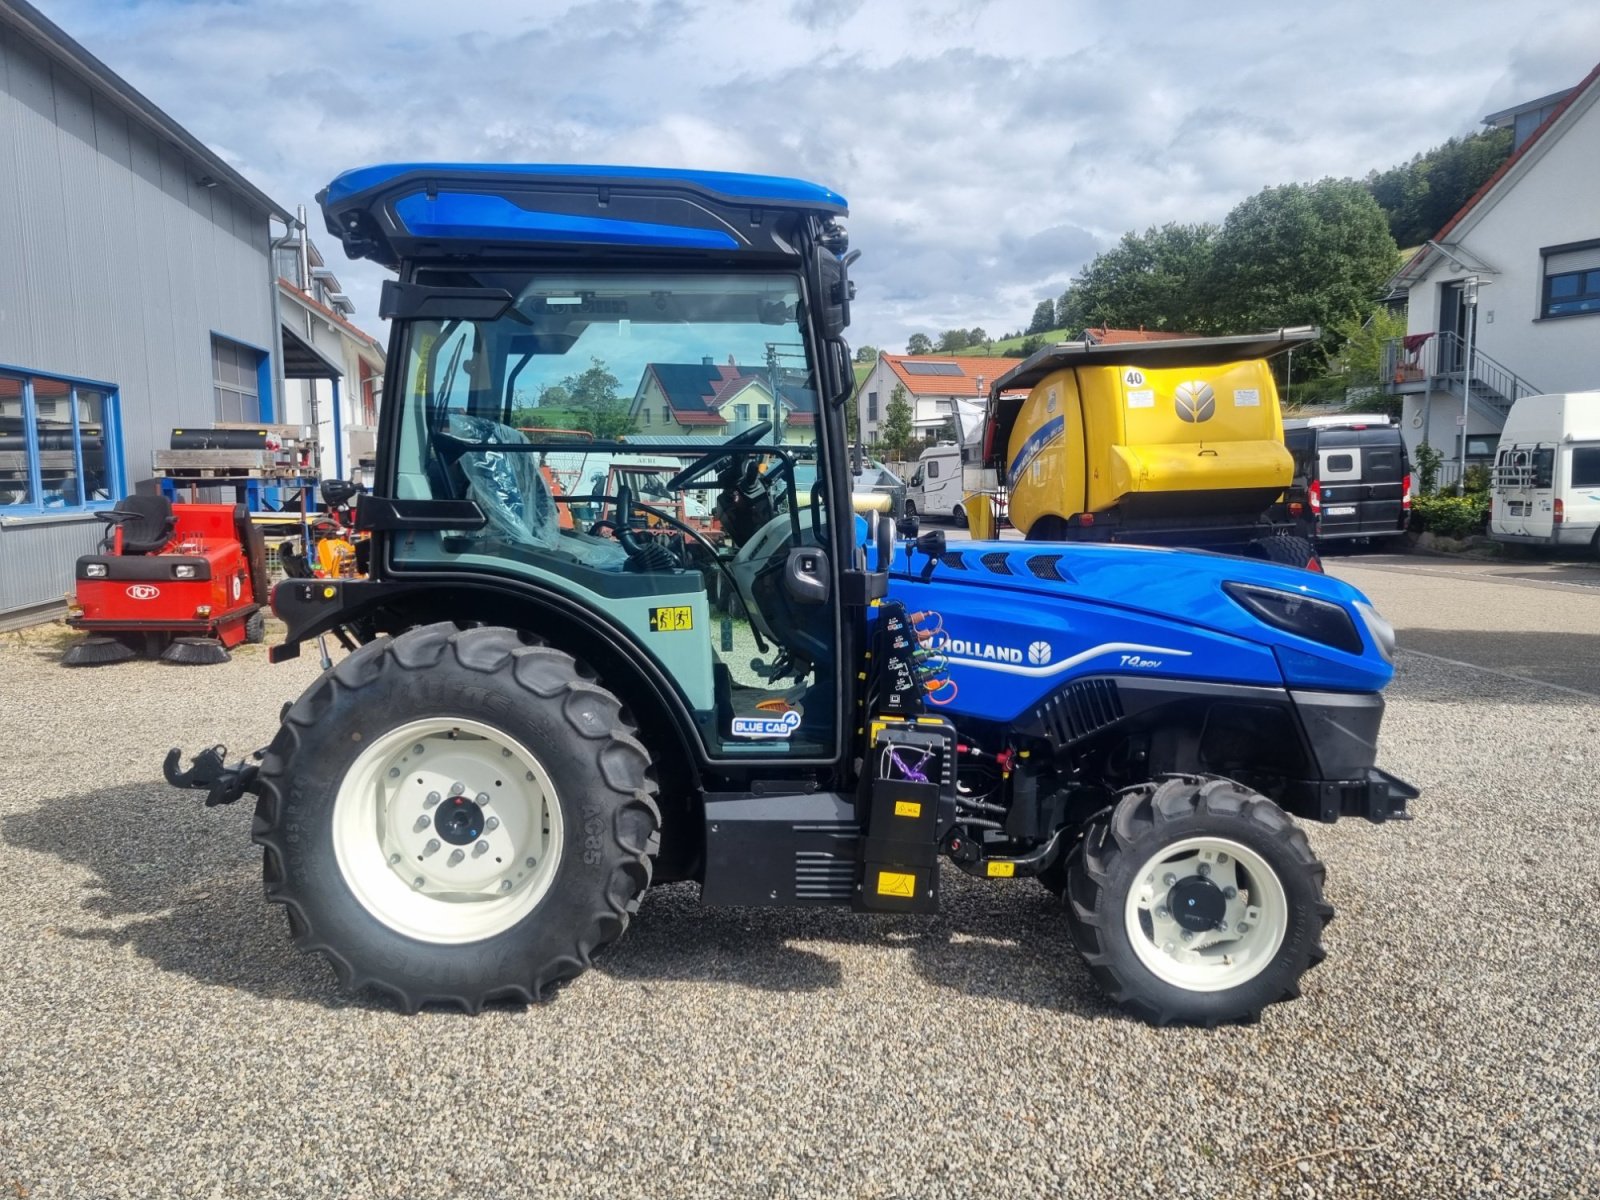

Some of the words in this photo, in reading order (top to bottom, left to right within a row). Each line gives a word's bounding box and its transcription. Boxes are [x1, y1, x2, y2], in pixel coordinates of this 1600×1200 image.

[1126, 372, 1143, 384] 40
[1412, 408, 1424, 430] 6
[939, 637, 1023, 664] HOLLAND
[735, 721, 763, 732] BLUE
[765, 723, 788, 733] CAB
[785, 714, 798, 725] 4
[583, 806, 605, 865] AC85
